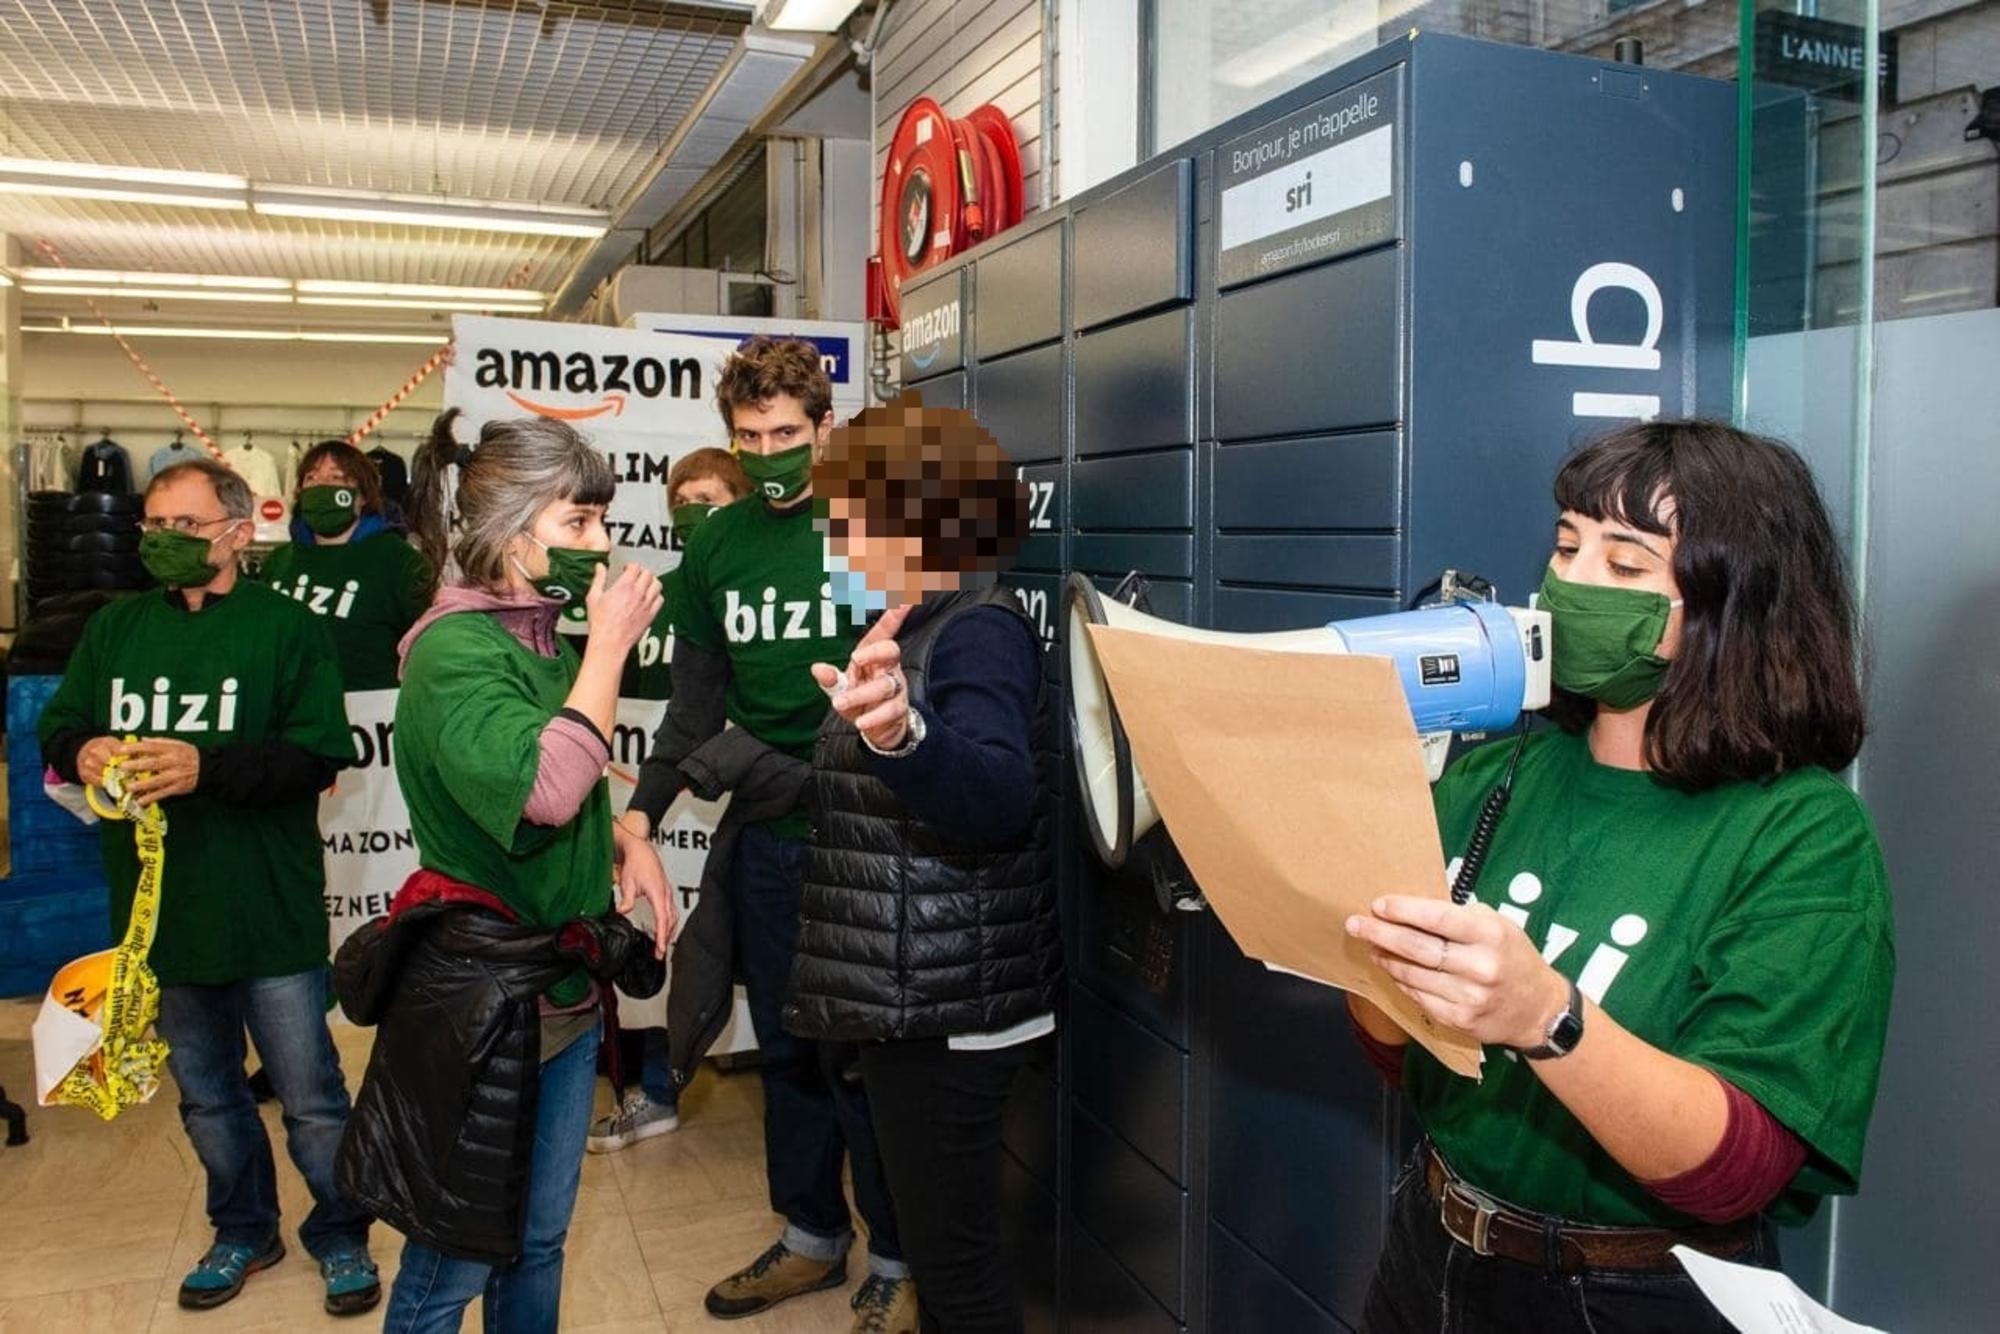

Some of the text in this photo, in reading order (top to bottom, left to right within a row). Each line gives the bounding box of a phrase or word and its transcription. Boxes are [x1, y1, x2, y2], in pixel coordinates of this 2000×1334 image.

[1232, 92, 1379, 174] Bonjour, je m'appelle
[1285, 171, 1313, 214] sri
[903, 299, 960, 353] amazon
[475, 347, 701, 400] amazon
[607, 452, 669, 485] LIM
[724, 582, 837, 643] bizi
[638, 623, 676, 669] bi
[110, 676, 239, 732] bizi
[321, 829, 415, 854] MAZON
